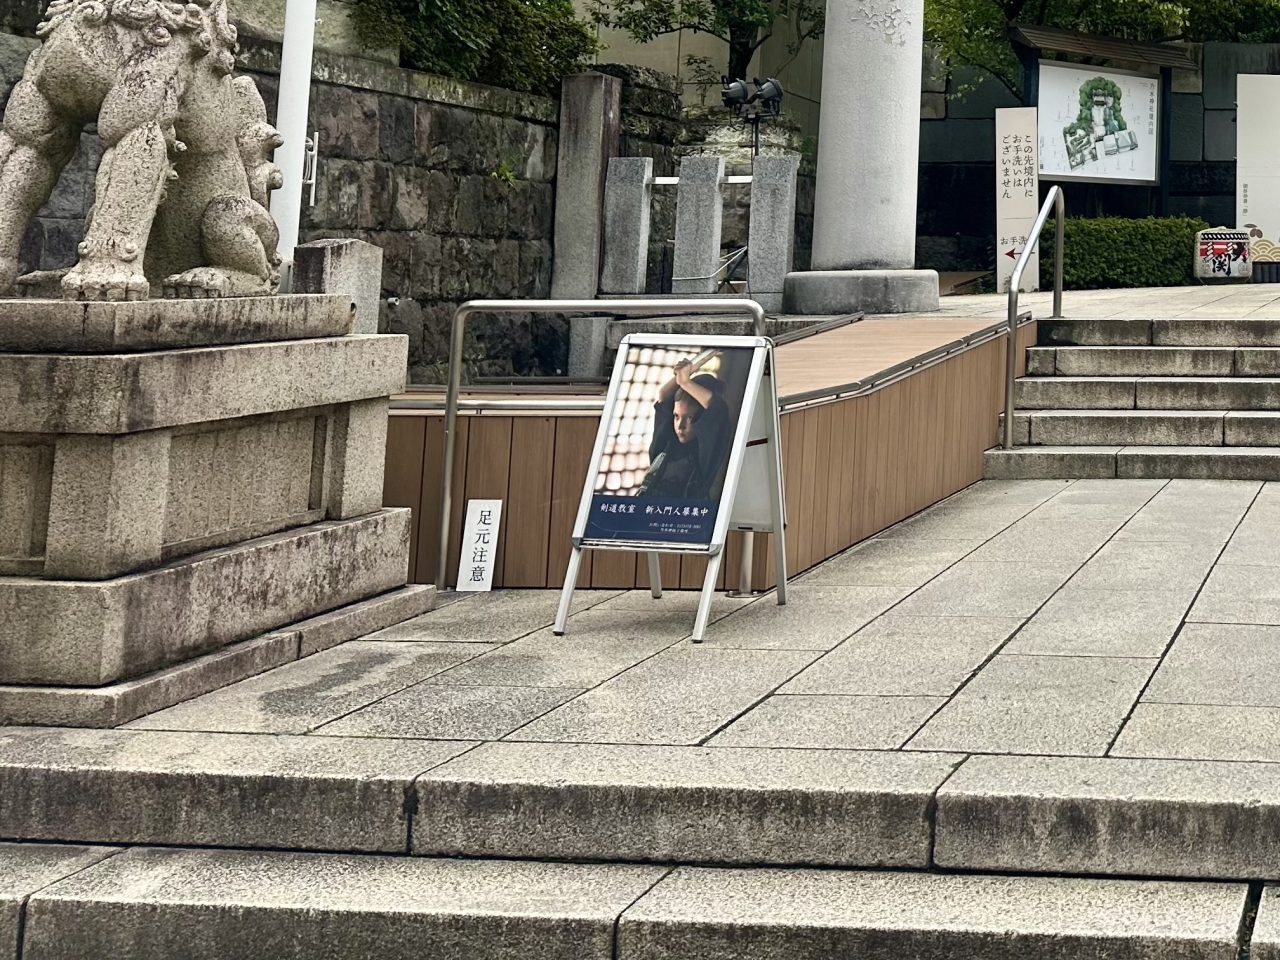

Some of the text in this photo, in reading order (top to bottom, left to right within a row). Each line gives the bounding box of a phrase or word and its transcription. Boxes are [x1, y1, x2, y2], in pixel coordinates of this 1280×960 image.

[1001, 135, 1012, 199] ございません
[1012, 135, 1023, 187] お手洗いは
[1023, 135, 1035, 198] この先境内に
[469, 510, 492, 582] 足元注意
